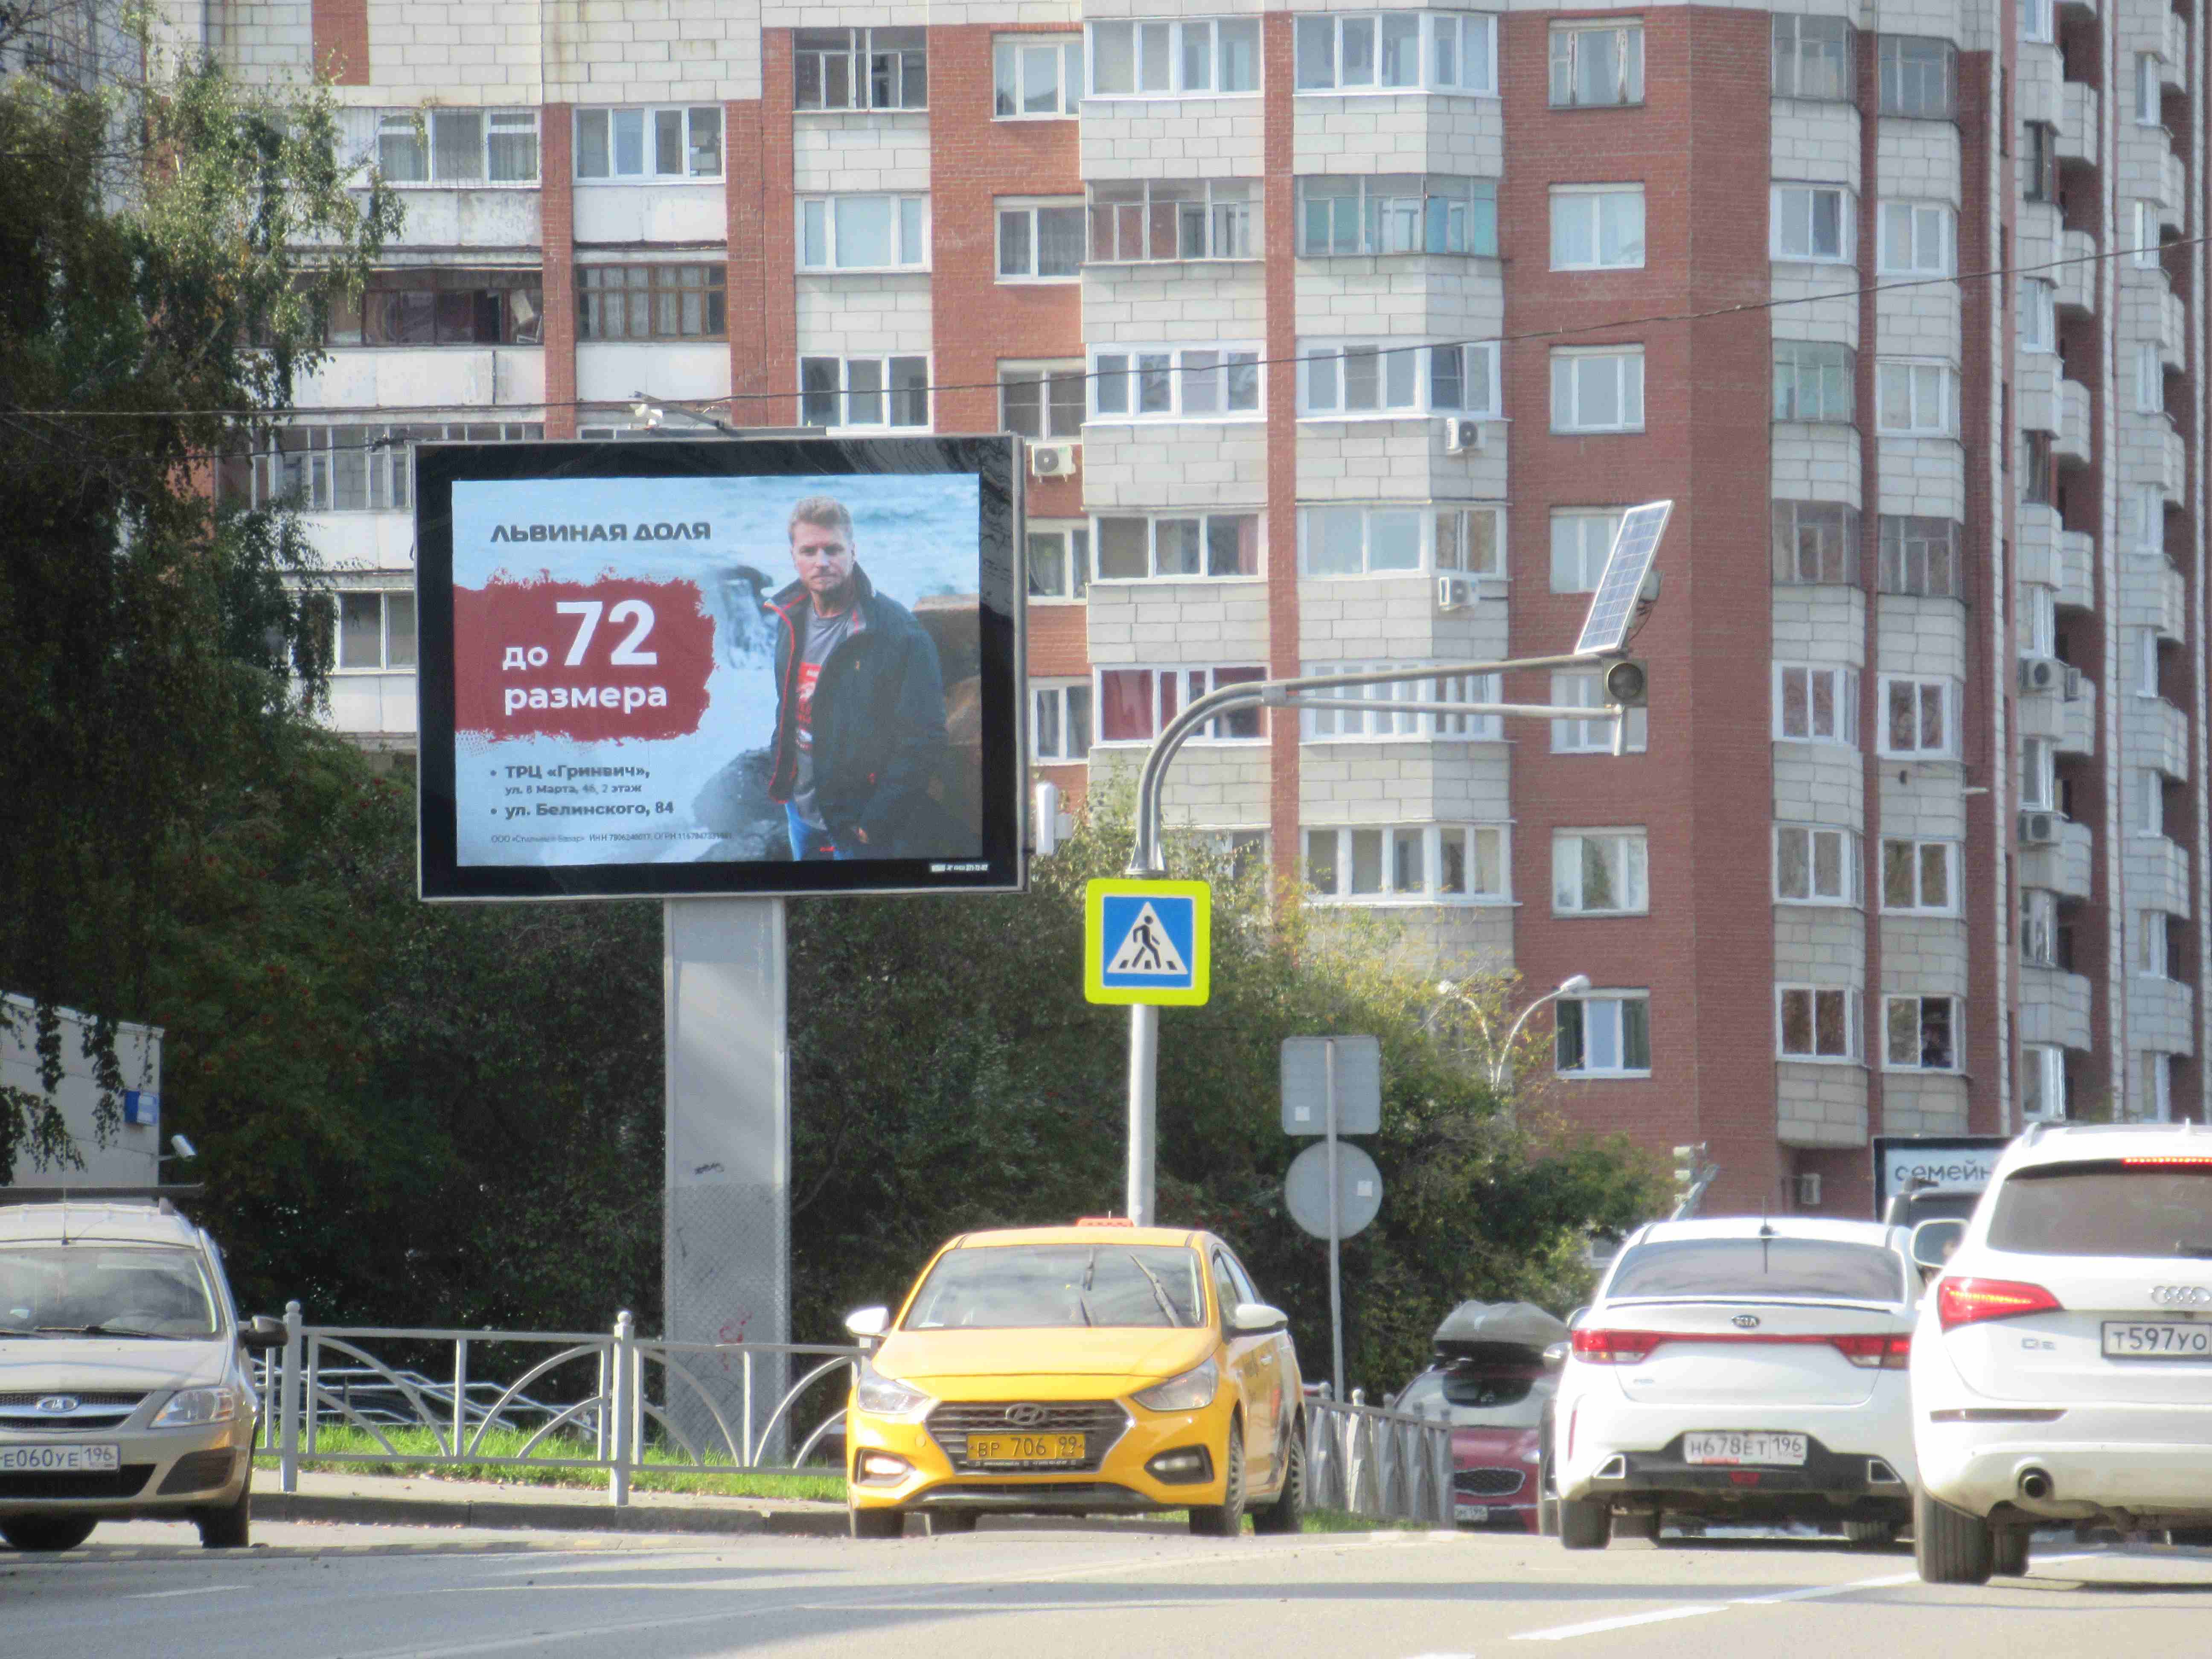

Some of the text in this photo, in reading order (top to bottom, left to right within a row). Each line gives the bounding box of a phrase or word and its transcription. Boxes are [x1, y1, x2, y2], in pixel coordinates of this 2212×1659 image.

[490, 521, 711, 542] ЛЬВИНАЯ ДОЛЯ
[502, 599, 658, 670] до 72
[505, 684, 667, 716] размера
[505, 765, 649, 780] ТРЦ «Гринвич»,
[505, 786, 523, 796] ул.
[536, 785, 578, 795] Марта,
[602, 784, 608, 793] 2
[611, 785, 641, 793] этаж
[505, 801, 674, 820] ул. Белинского, 84
[2113, 1327, 2207, 1351] Т597УО
[1010, 1437, 1046, 1457] 706
[1691, 1437, 1802, 1455] Н678ЕТ 196
[3, 1447, 112, 1467] Е060УЕ 196
